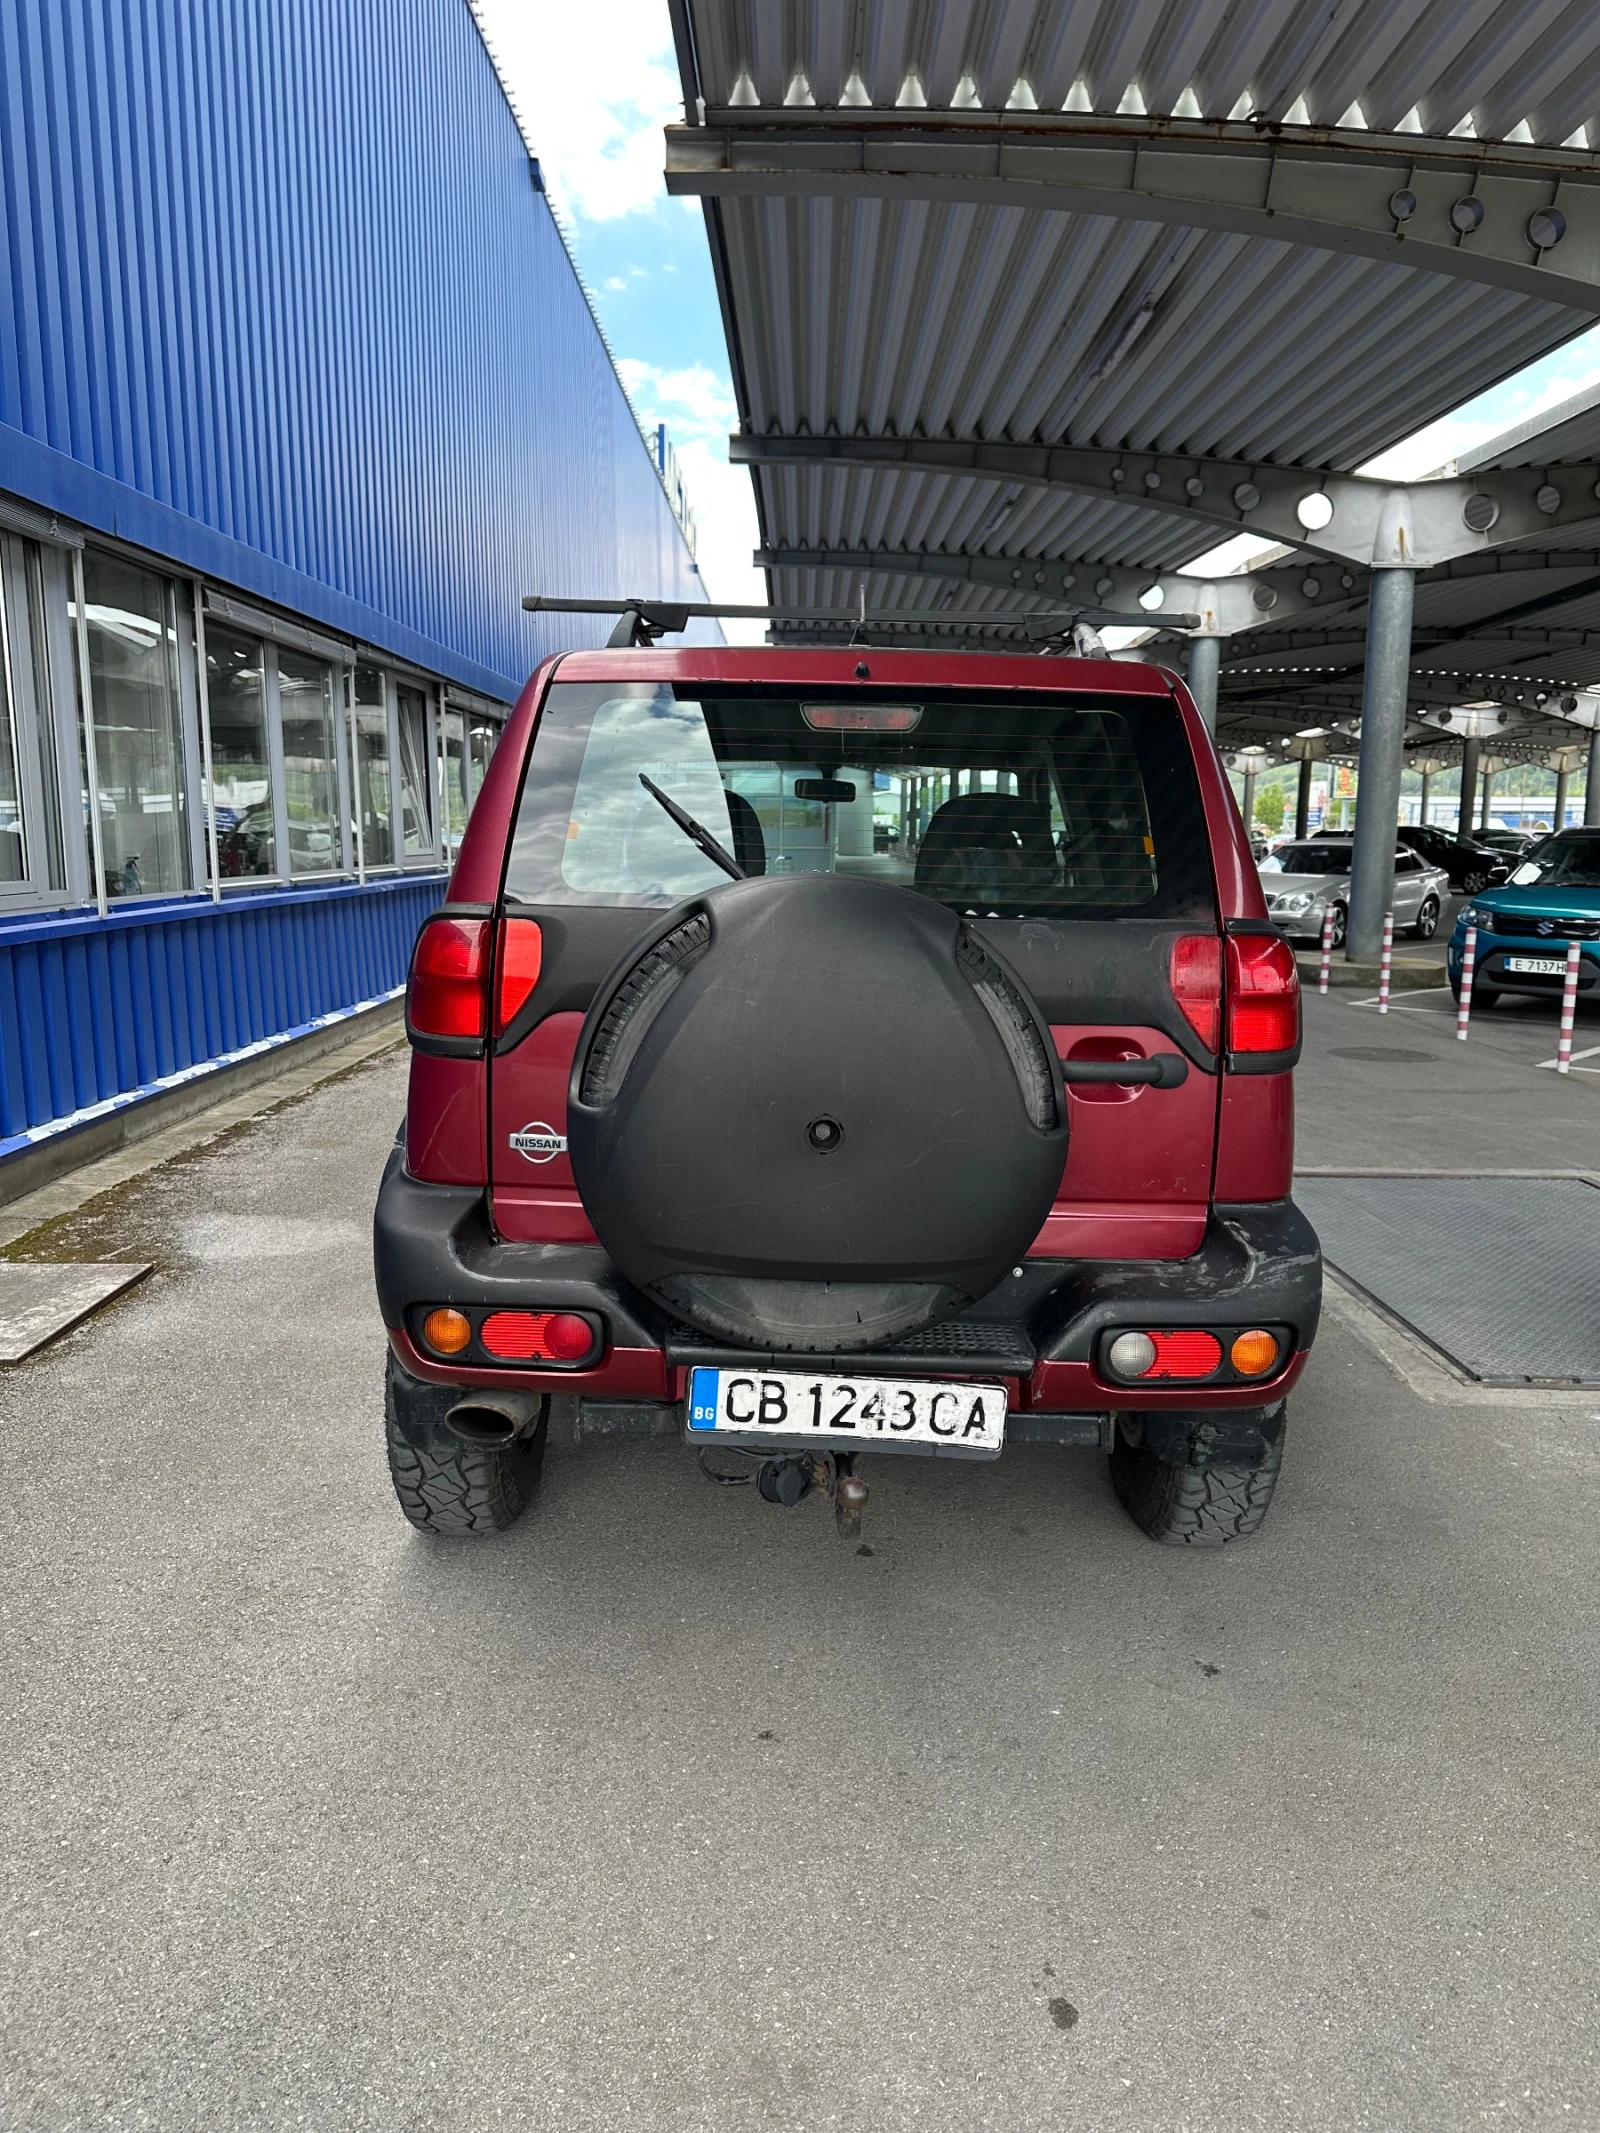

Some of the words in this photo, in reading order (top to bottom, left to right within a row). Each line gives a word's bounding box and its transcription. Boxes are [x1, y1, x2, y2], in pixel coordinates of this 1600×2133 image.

[1515, 960, 1522, 970] E
[1528, 961, 1555, 972] 7137
[515, 1138, 561, 1149] NISSAN
[694, 1406, 714, 1420] BG
[725, 1378, 788, 1424] CB
[809, 1383, 917, 1431] 1243
[929, 1392, 986, 1438] CA
